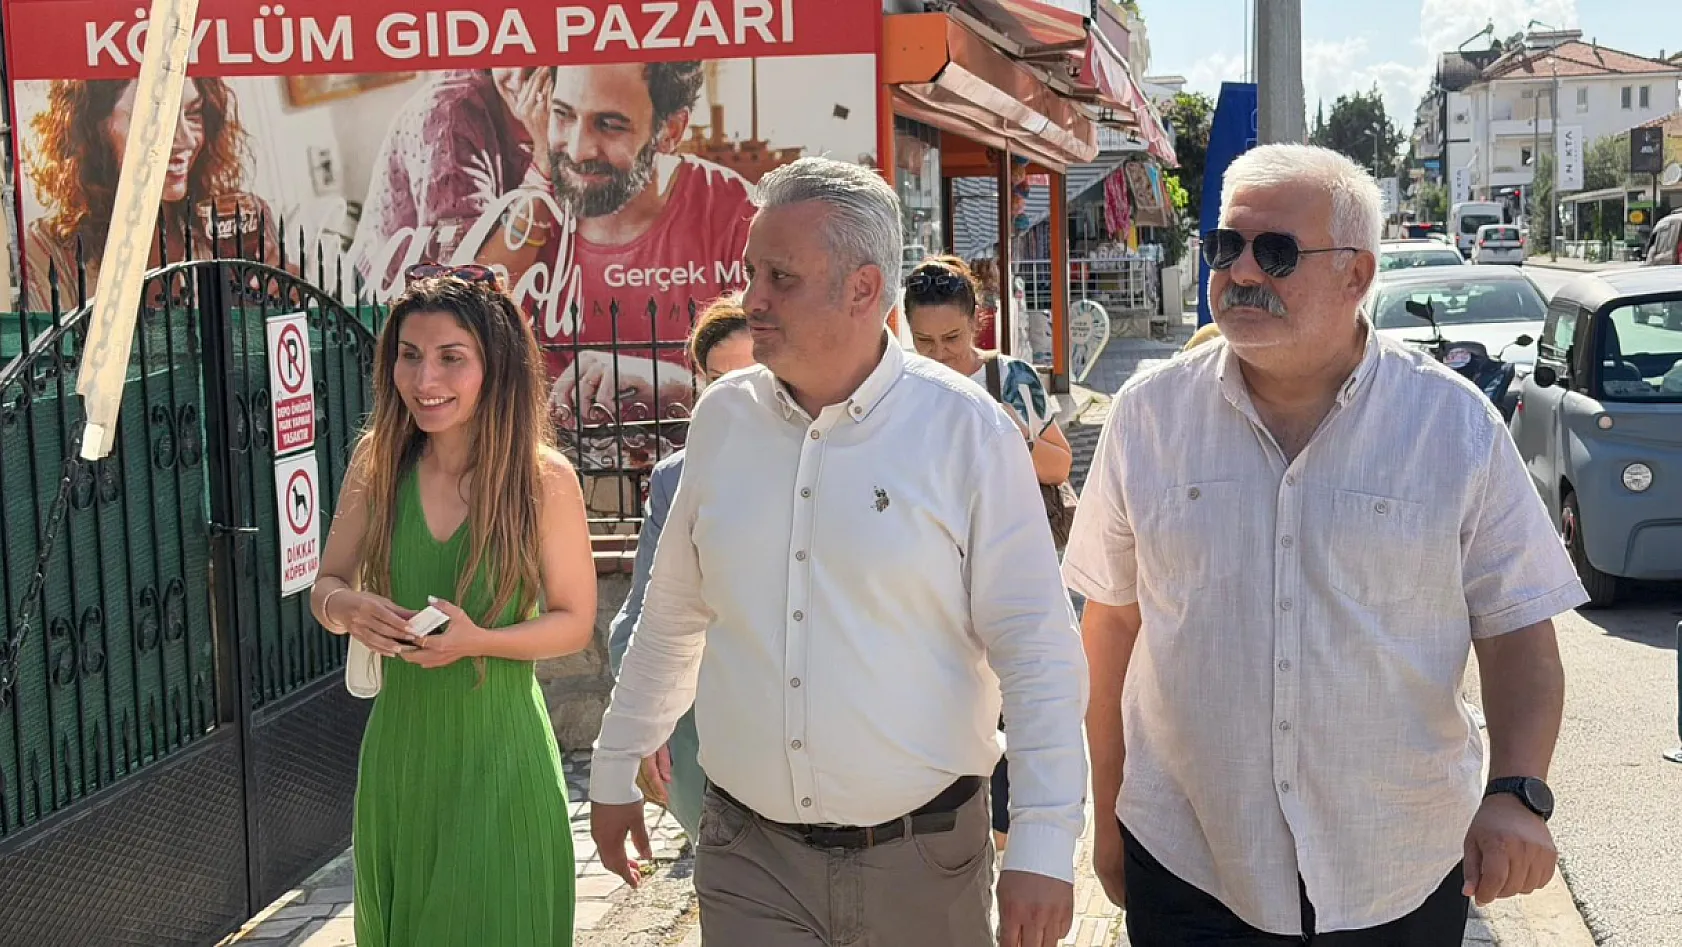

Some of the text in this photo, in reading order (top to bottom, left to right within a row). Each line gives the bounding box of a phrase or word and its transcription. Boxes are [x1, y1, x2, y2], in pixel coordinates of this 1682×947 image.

[375, 8, 537, 59] GIDA
[556, 0, 794, 52] PAZARI
[604, 261, 707, 292] Gerçek
[287, 538, 316, 564] DİKKAT
[284, 556, 319, 582] KÖPEK VAR
